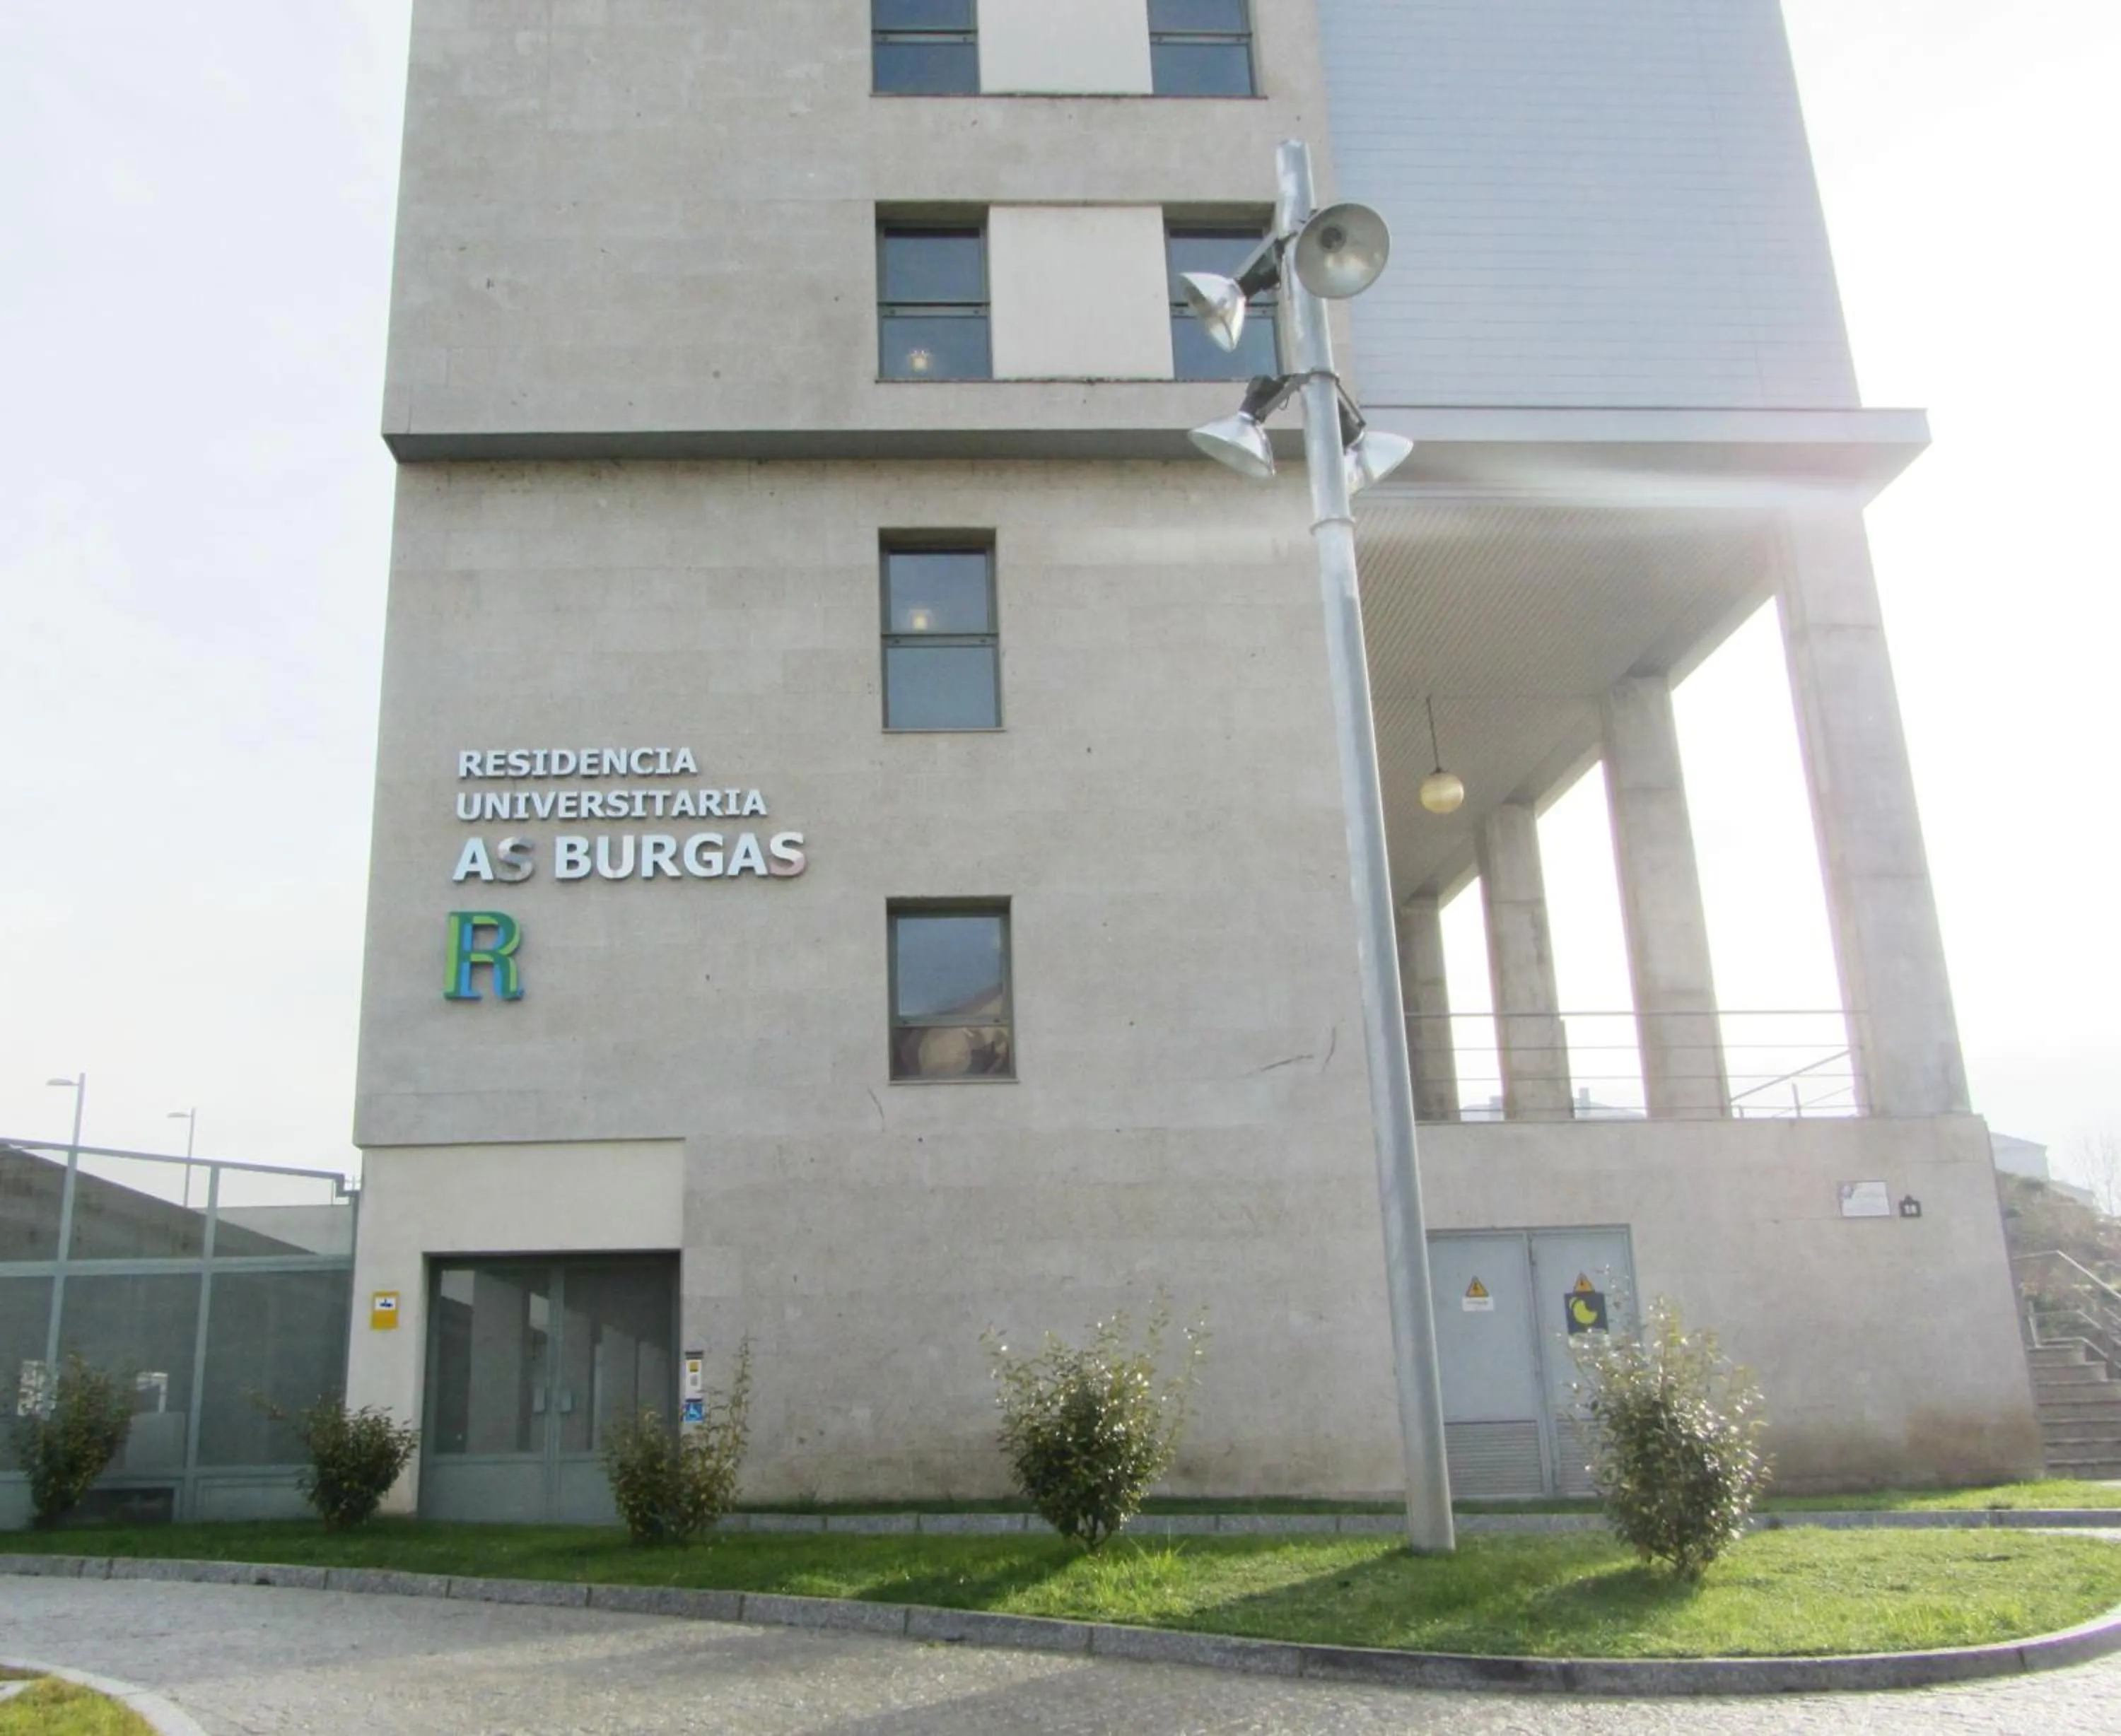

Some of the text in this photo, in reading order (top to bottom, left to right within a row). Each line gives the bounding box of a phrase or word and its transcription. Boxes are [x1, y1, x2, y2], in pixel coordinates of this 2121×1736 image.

[458, 746, 699, 778] RESIDENCIA
[455, 788, 768, 821] UNIVERSITARIA
[451, 831, 807, 883] AS BURGAS
